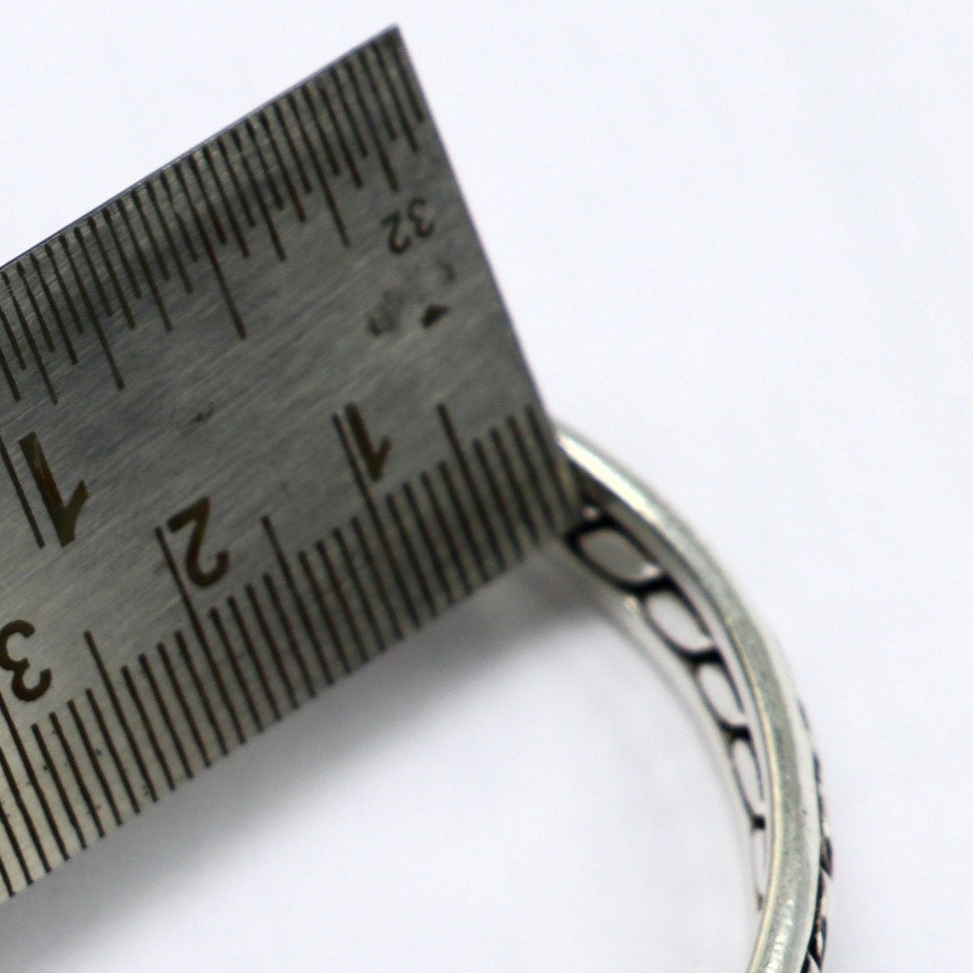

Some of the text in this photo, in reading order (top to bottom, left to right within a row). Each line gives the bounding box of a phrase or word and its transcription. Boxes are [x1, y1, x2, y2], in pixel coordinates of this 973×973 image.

[381, 197, 435, 255] 32
[345, 403, 391, 481] 1
[20, 432, 89, 547] 1
[168, 497, 227, 588] 2
